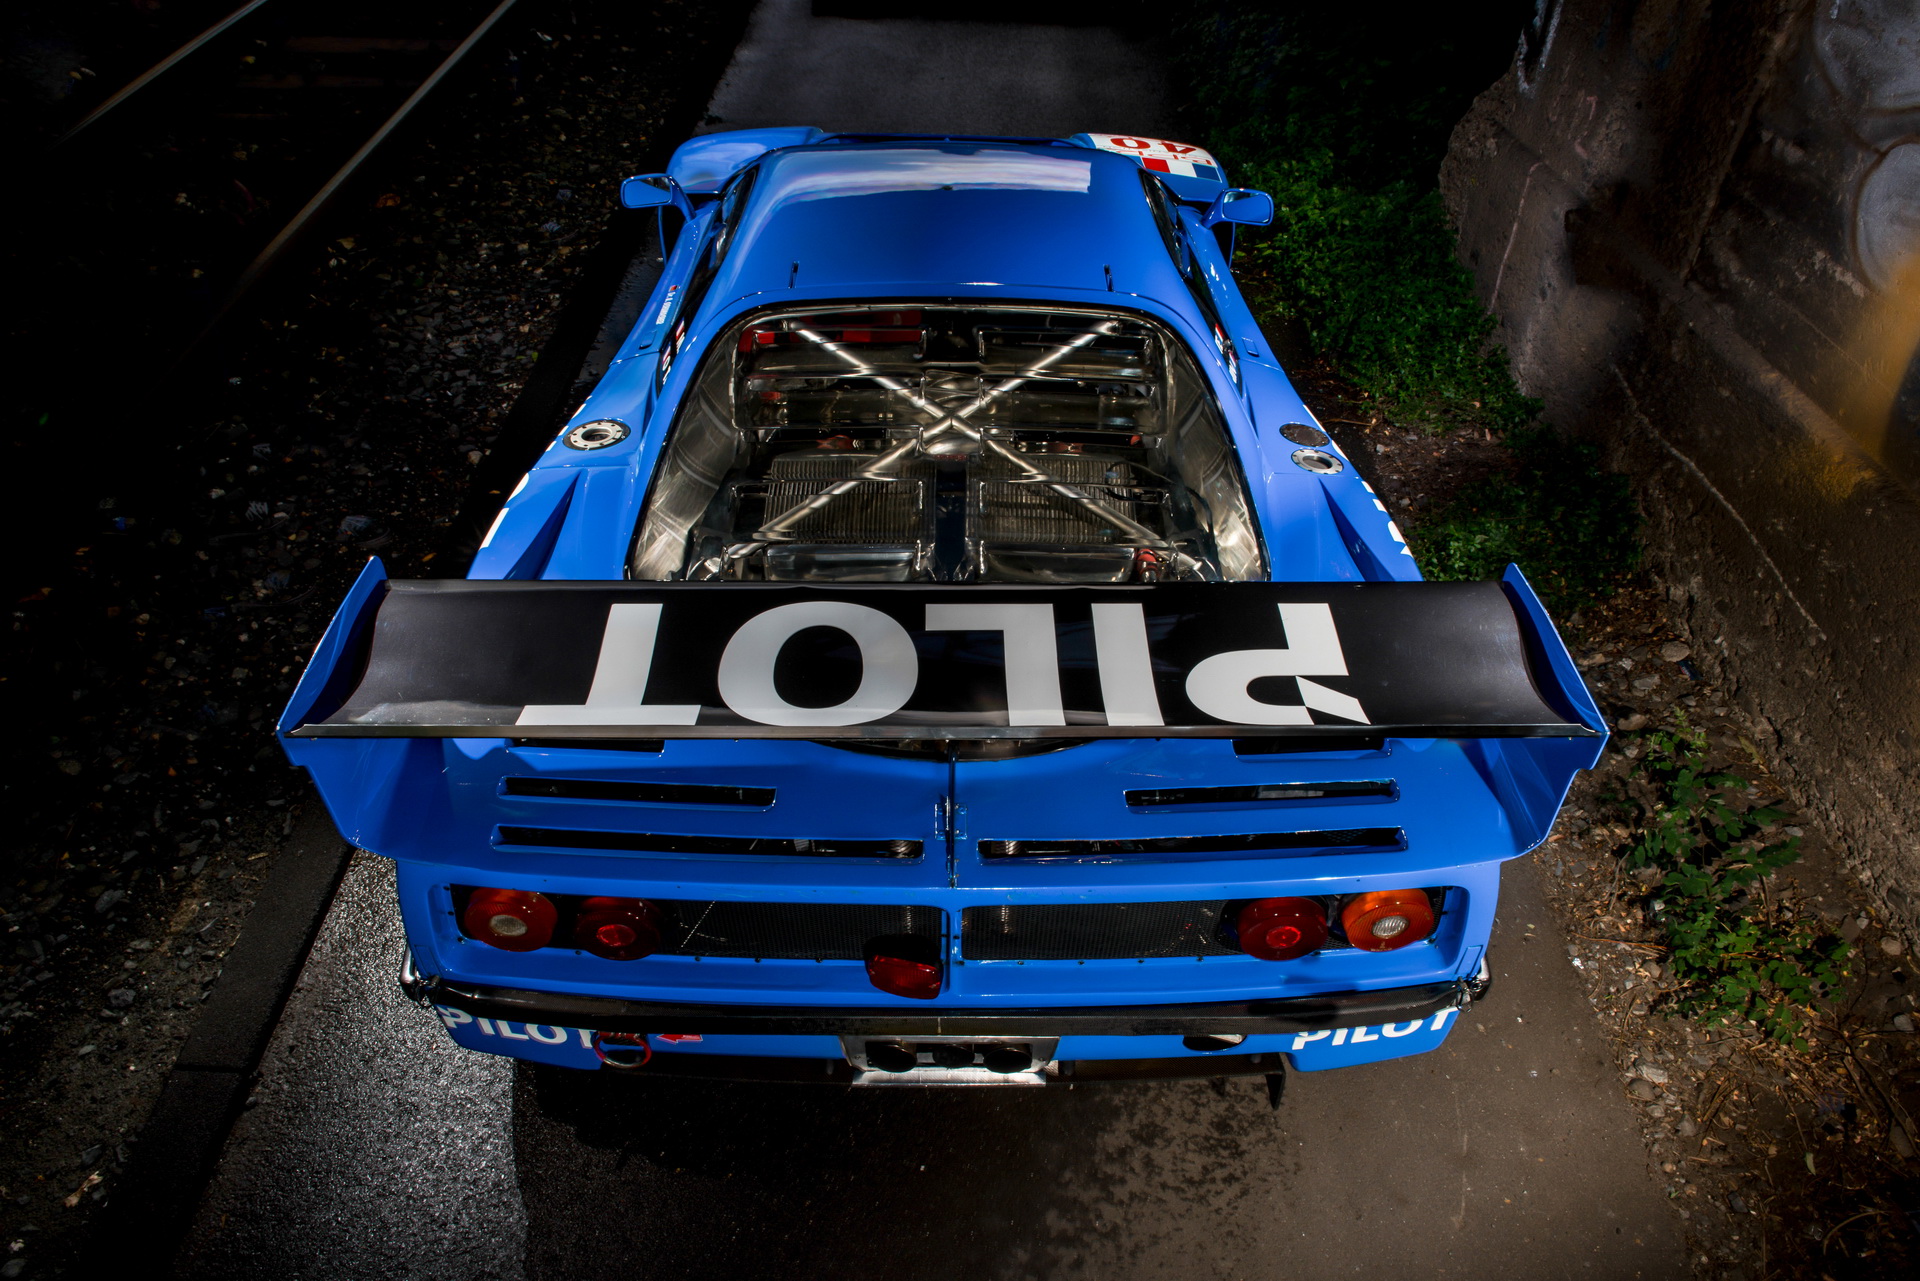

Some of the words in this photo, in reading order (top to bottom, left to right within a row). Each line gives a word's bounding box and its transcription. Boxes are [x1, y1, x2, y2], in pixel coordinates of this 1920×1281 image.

[1110, 137, 1197, 154] 40
[516, 601, 1371, 727] PILOT
[437, 1006, 597, 1050] PILOT
[1291, 1006, 1459, 1050] PILOT
